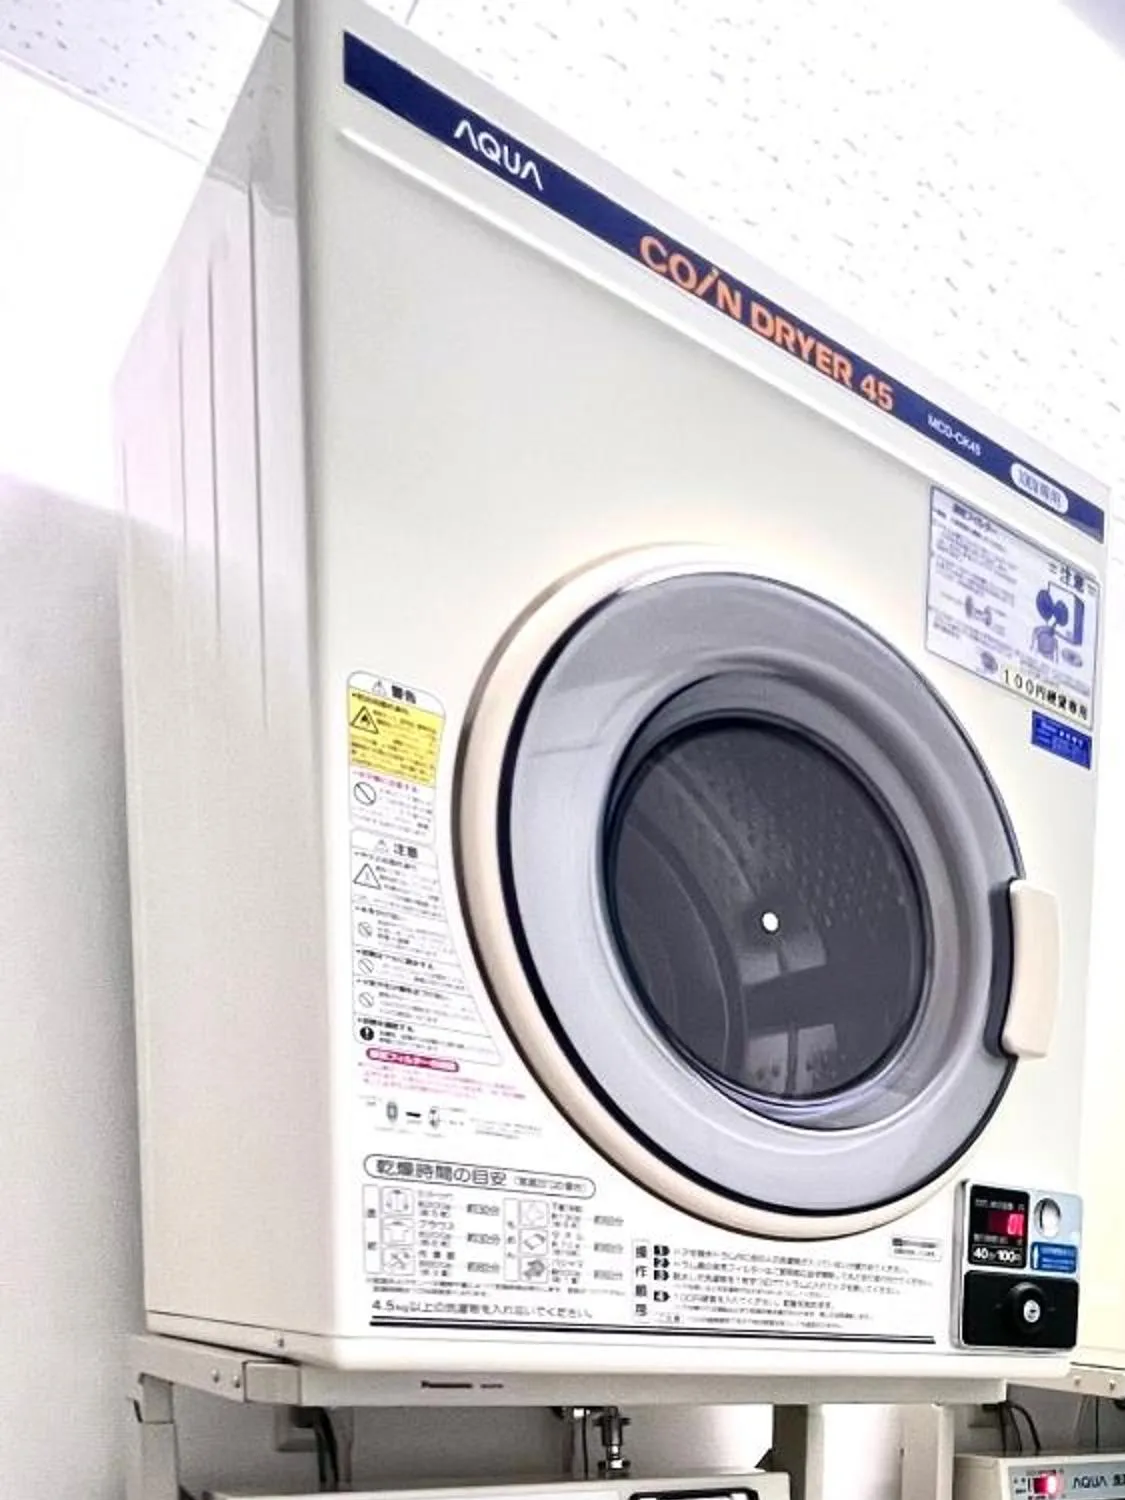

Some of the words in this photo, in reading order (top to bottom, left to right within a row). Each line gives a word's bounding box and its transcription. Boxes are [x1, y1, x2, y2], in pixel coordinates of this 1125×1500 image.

[453, 119, 544, 191] AQUA
[750, 301, 853, 388] DRYER
[860, 374, 894, 411] 45
